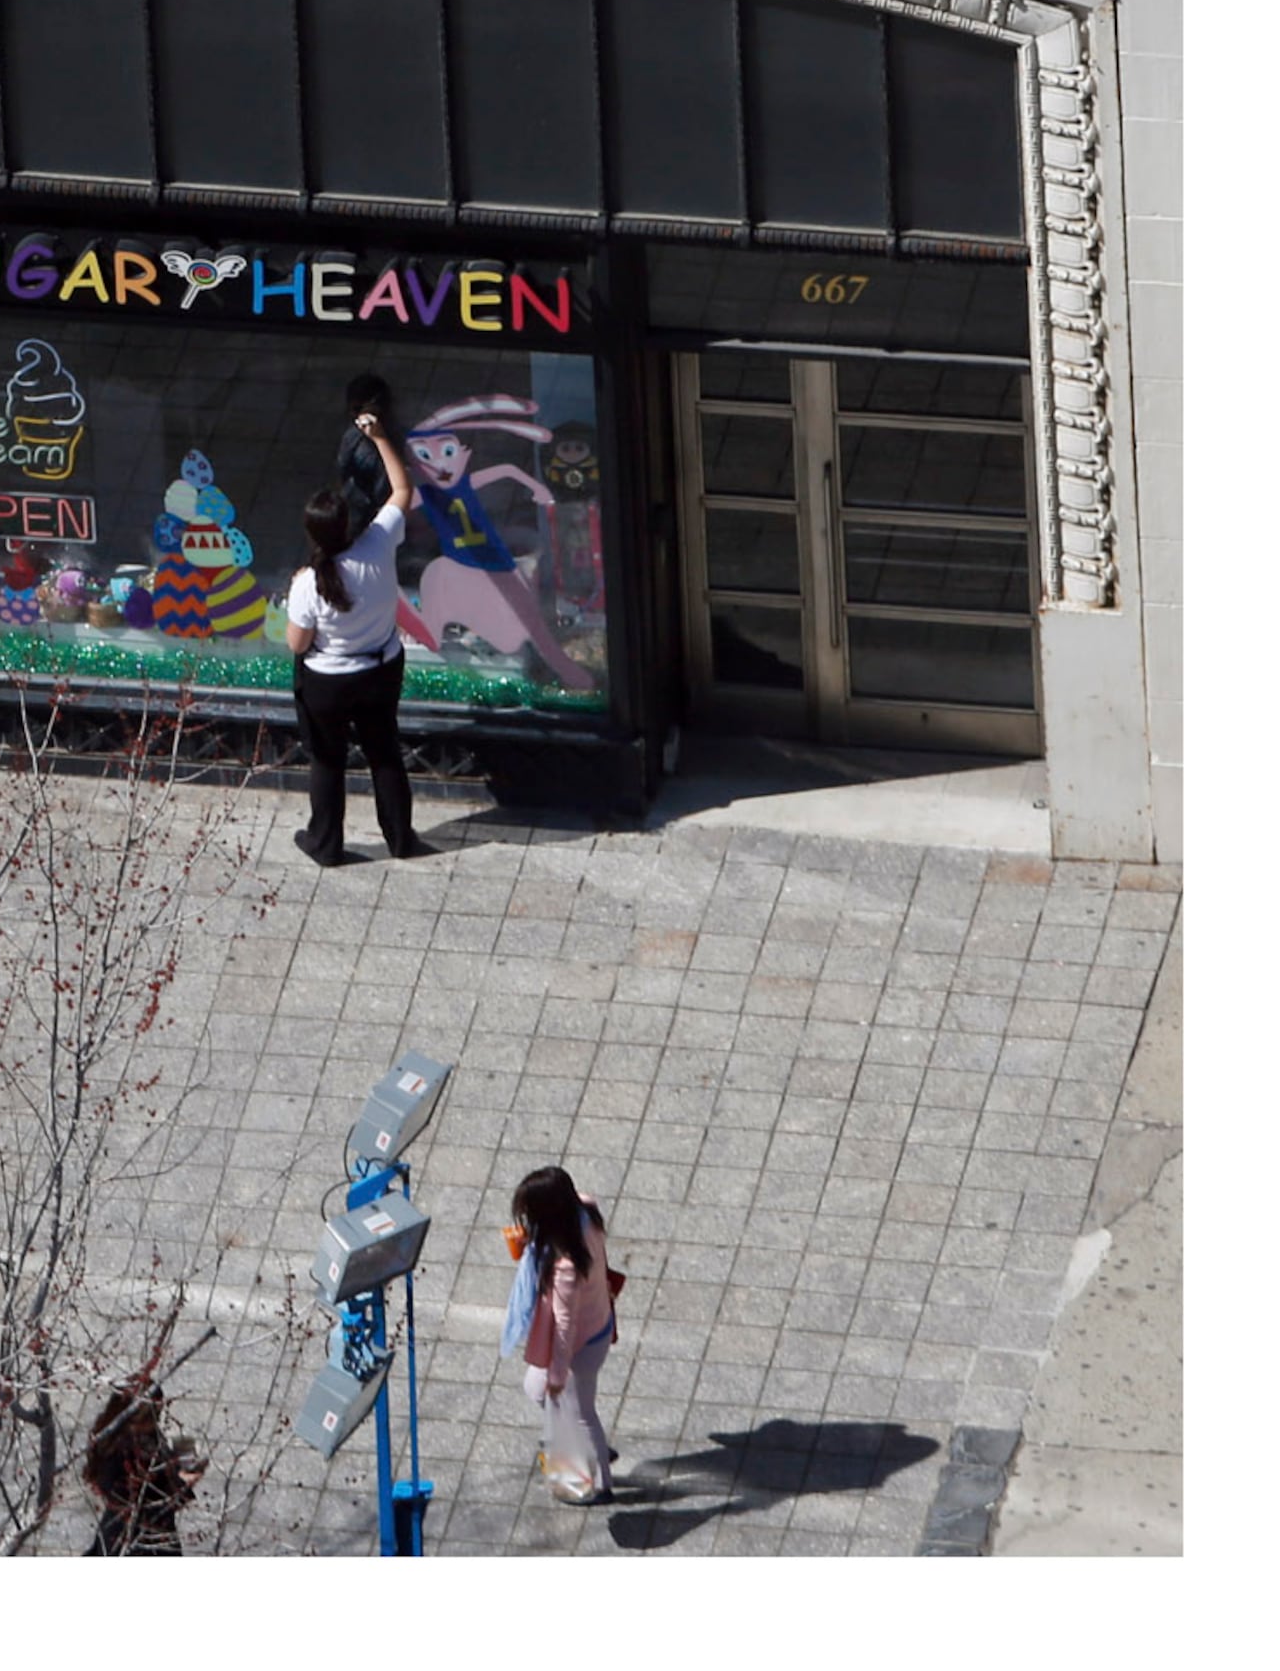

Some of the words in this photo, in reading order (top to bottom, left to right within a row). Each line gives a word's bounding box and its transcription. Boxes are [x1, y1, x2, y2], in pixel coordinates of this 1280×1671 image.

[251, 258, 570, 333] HEAVEN
[800, 273, 870, 305] 667
[448, 498, 488, 549] 1
